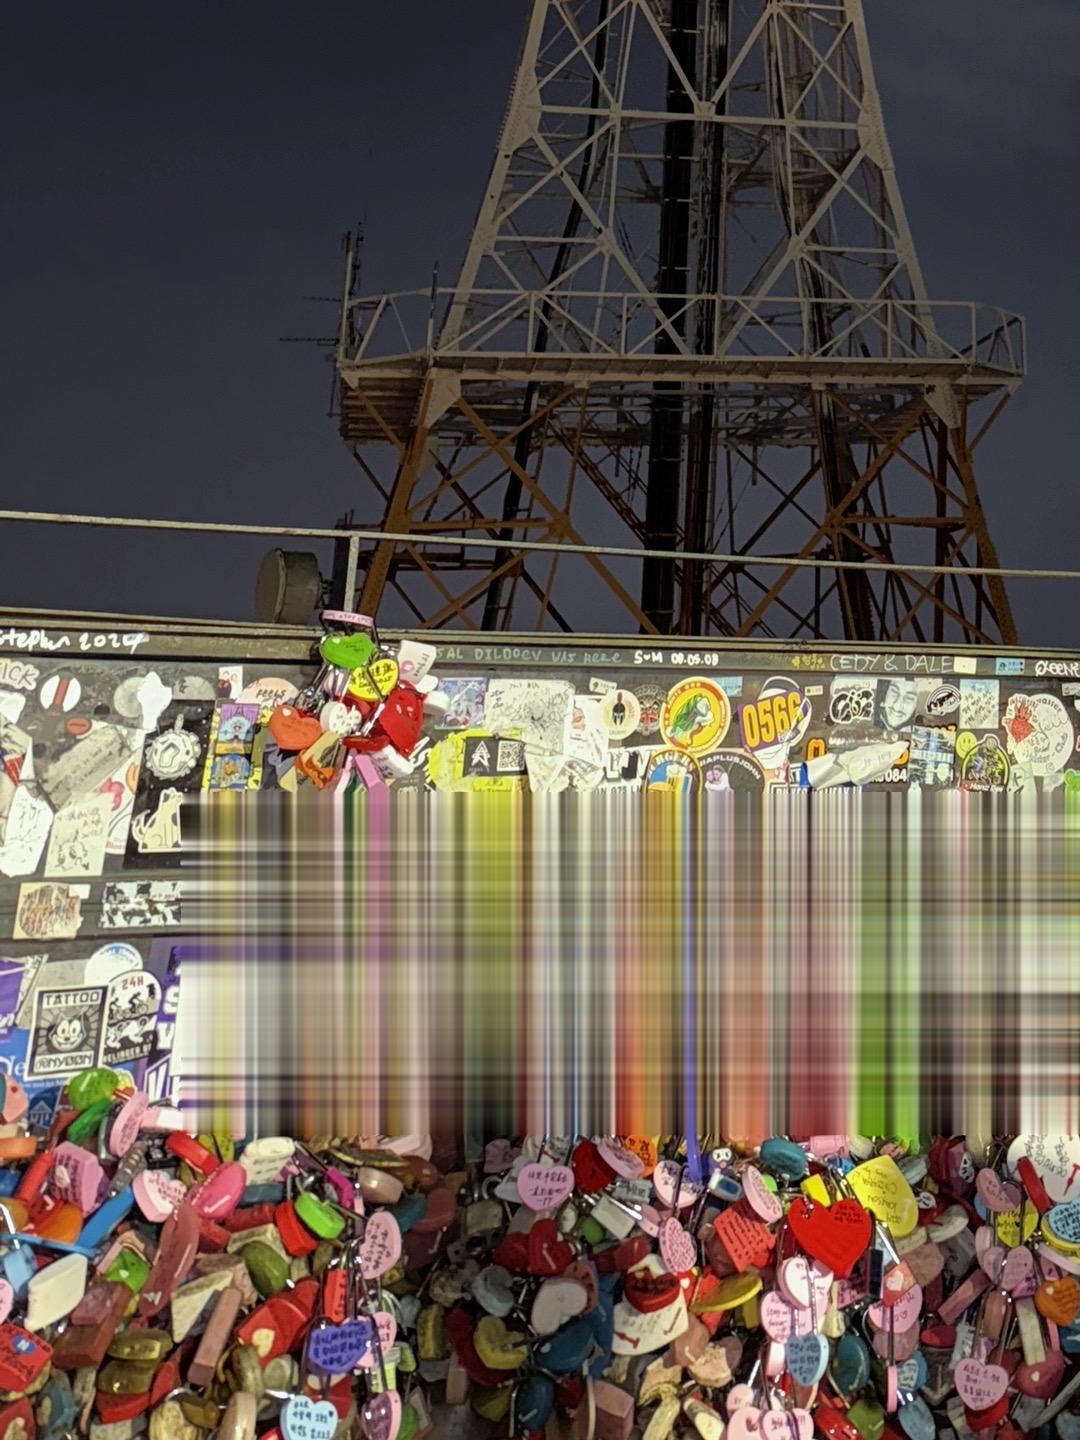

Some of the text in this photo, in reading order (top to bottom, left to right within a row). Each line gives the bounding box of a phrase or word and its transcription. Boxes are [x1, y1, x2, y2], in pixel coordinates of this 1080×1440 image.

[830, 654, 880, 671] CEDY
[905, 656, 954, 672] DALE
[742, 691, 802, 748] 0566
[121, 976, 145, 989] 24H
[45, 991, 100, 1006] TATTOO
